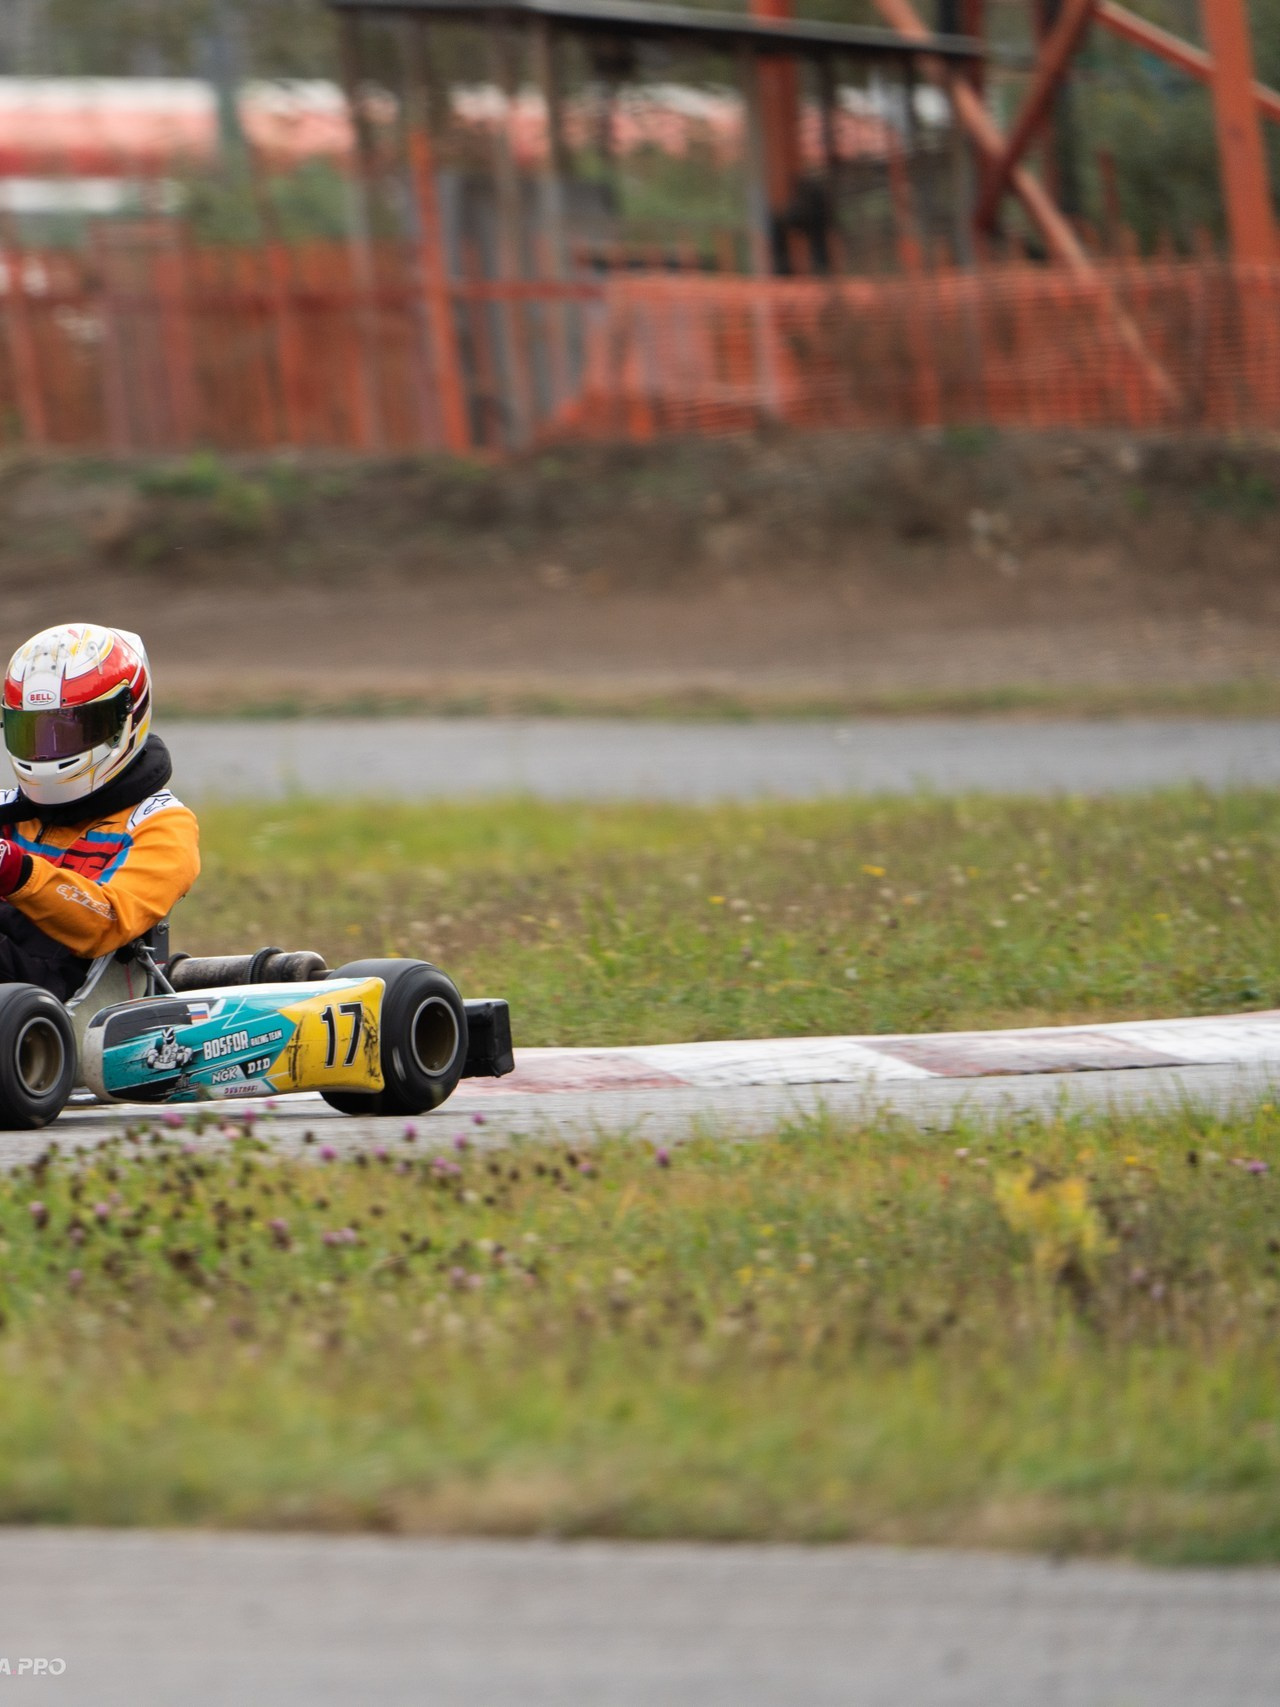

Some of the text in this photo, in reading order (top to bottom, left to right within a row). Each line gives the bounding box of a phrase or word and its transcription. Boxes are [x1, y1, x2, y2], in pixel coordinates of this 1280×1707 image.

[30, 693, 53, 701] BELL
[203, 1030, 249, 1060] BOSFOR
[269, 1029, 282, 1041] TEAM
[320, 1001, 363, 1068] 17
[212, 1064, 238, 1084] NGK
[247, 1057, 271, 1074] DID
